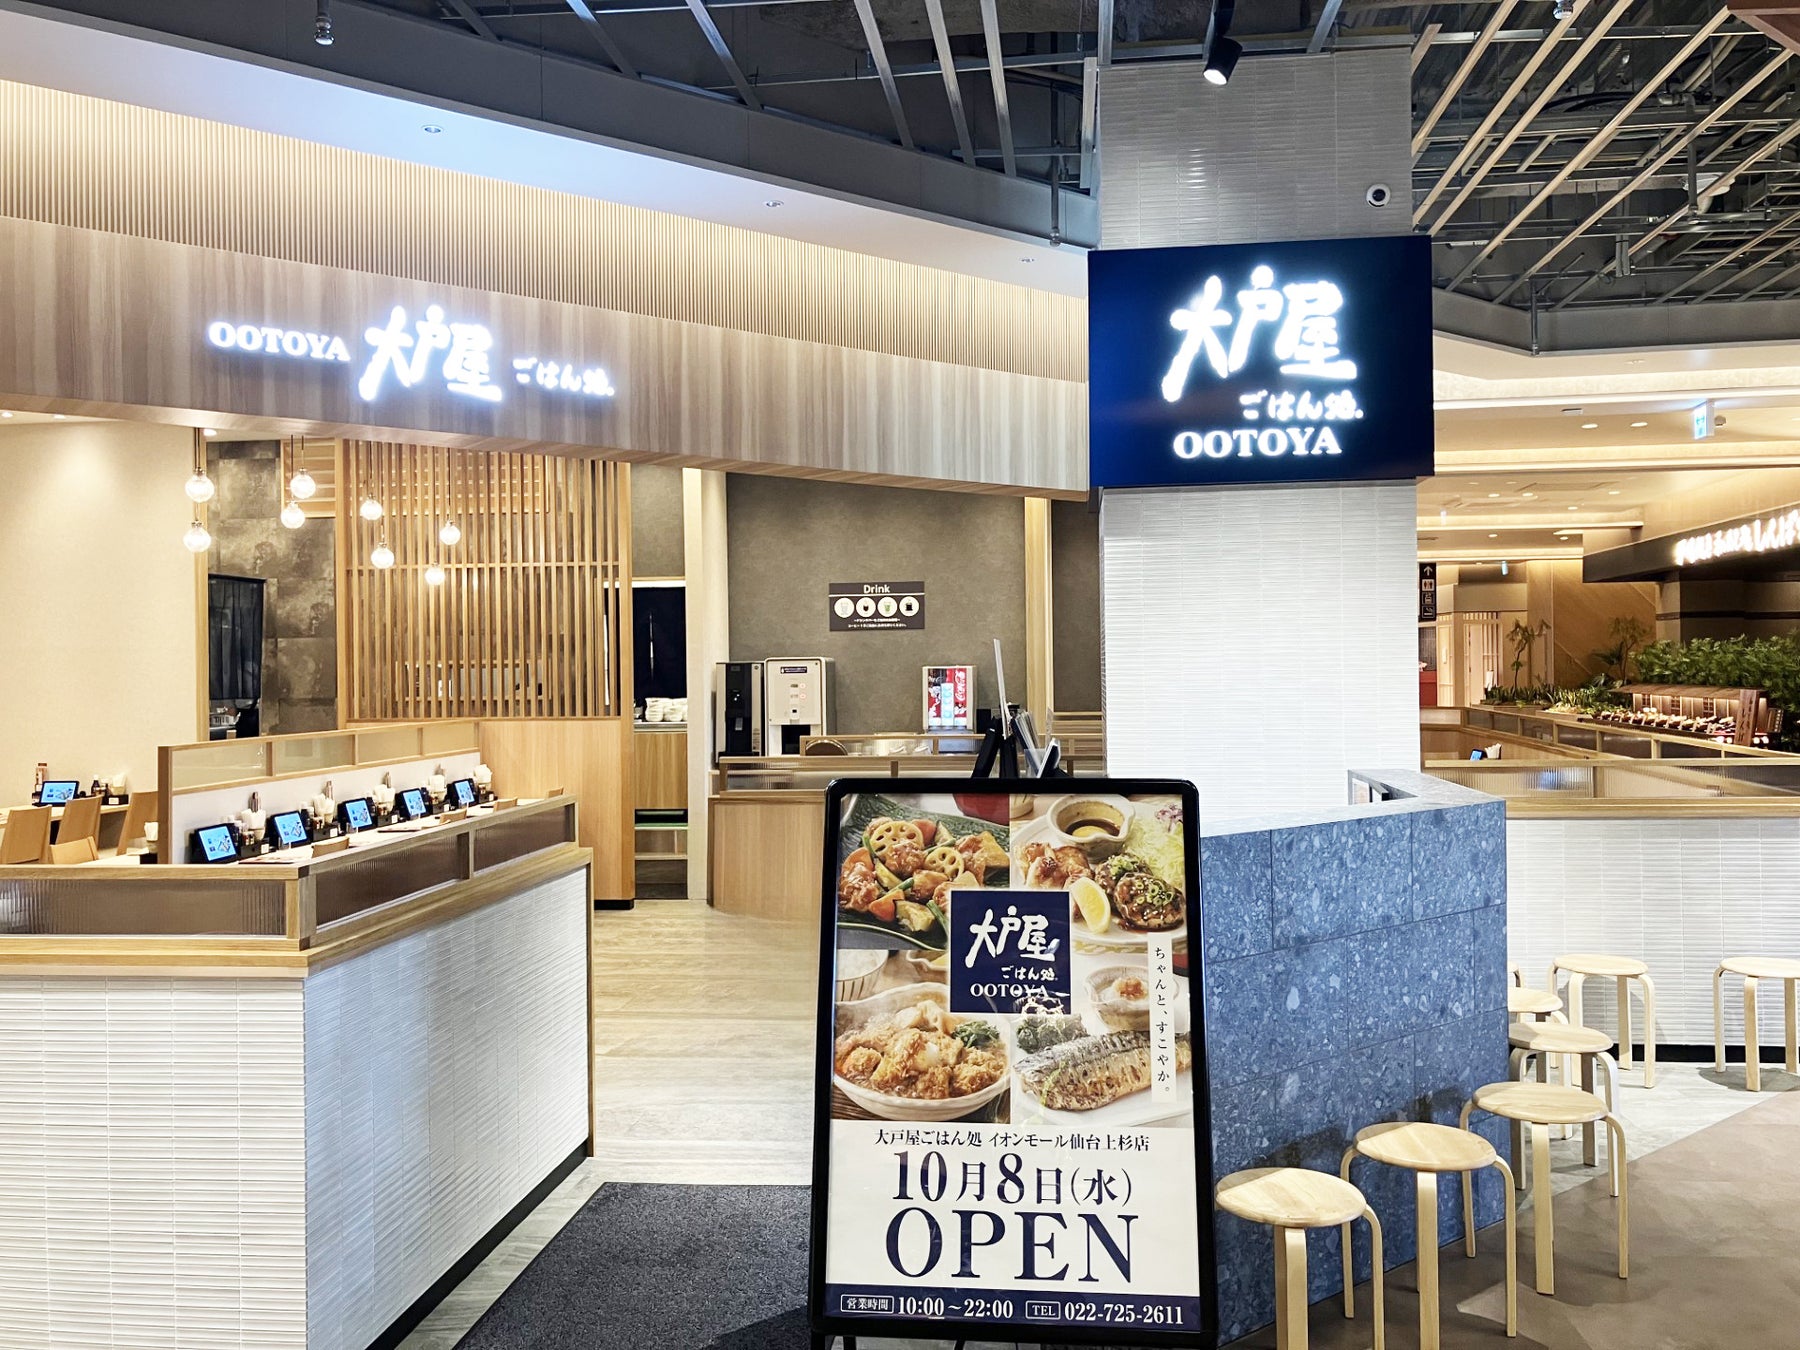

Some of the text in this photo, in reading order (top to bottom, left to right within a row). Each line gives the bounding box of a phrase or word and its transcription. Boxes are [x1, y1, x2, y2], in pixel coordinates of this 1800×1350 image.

[208, 321, 351, 362] OOTOYA
[358, 304, 503, 402] 大戸屋
[1161, 265, 1357, 403] 大戸屋
[1173, 427, 1342, 458] OOTOYA
[863, 584, 890, 594] Drink
[965, 905, 1056, 968] 大戸屋
[1155, 947, 1170, 1092] ちゃんと、すこやか。
[875, 1129, 1150, 1151] 大戸屋ごはん処 イオンモール仙台上杉店
[885, 1206, 1139, 1283] OPEN
[846, 1297, 889, 1311] 営業時間
[1031, 1302, 1184, 1325] TEL 022-725-2611
